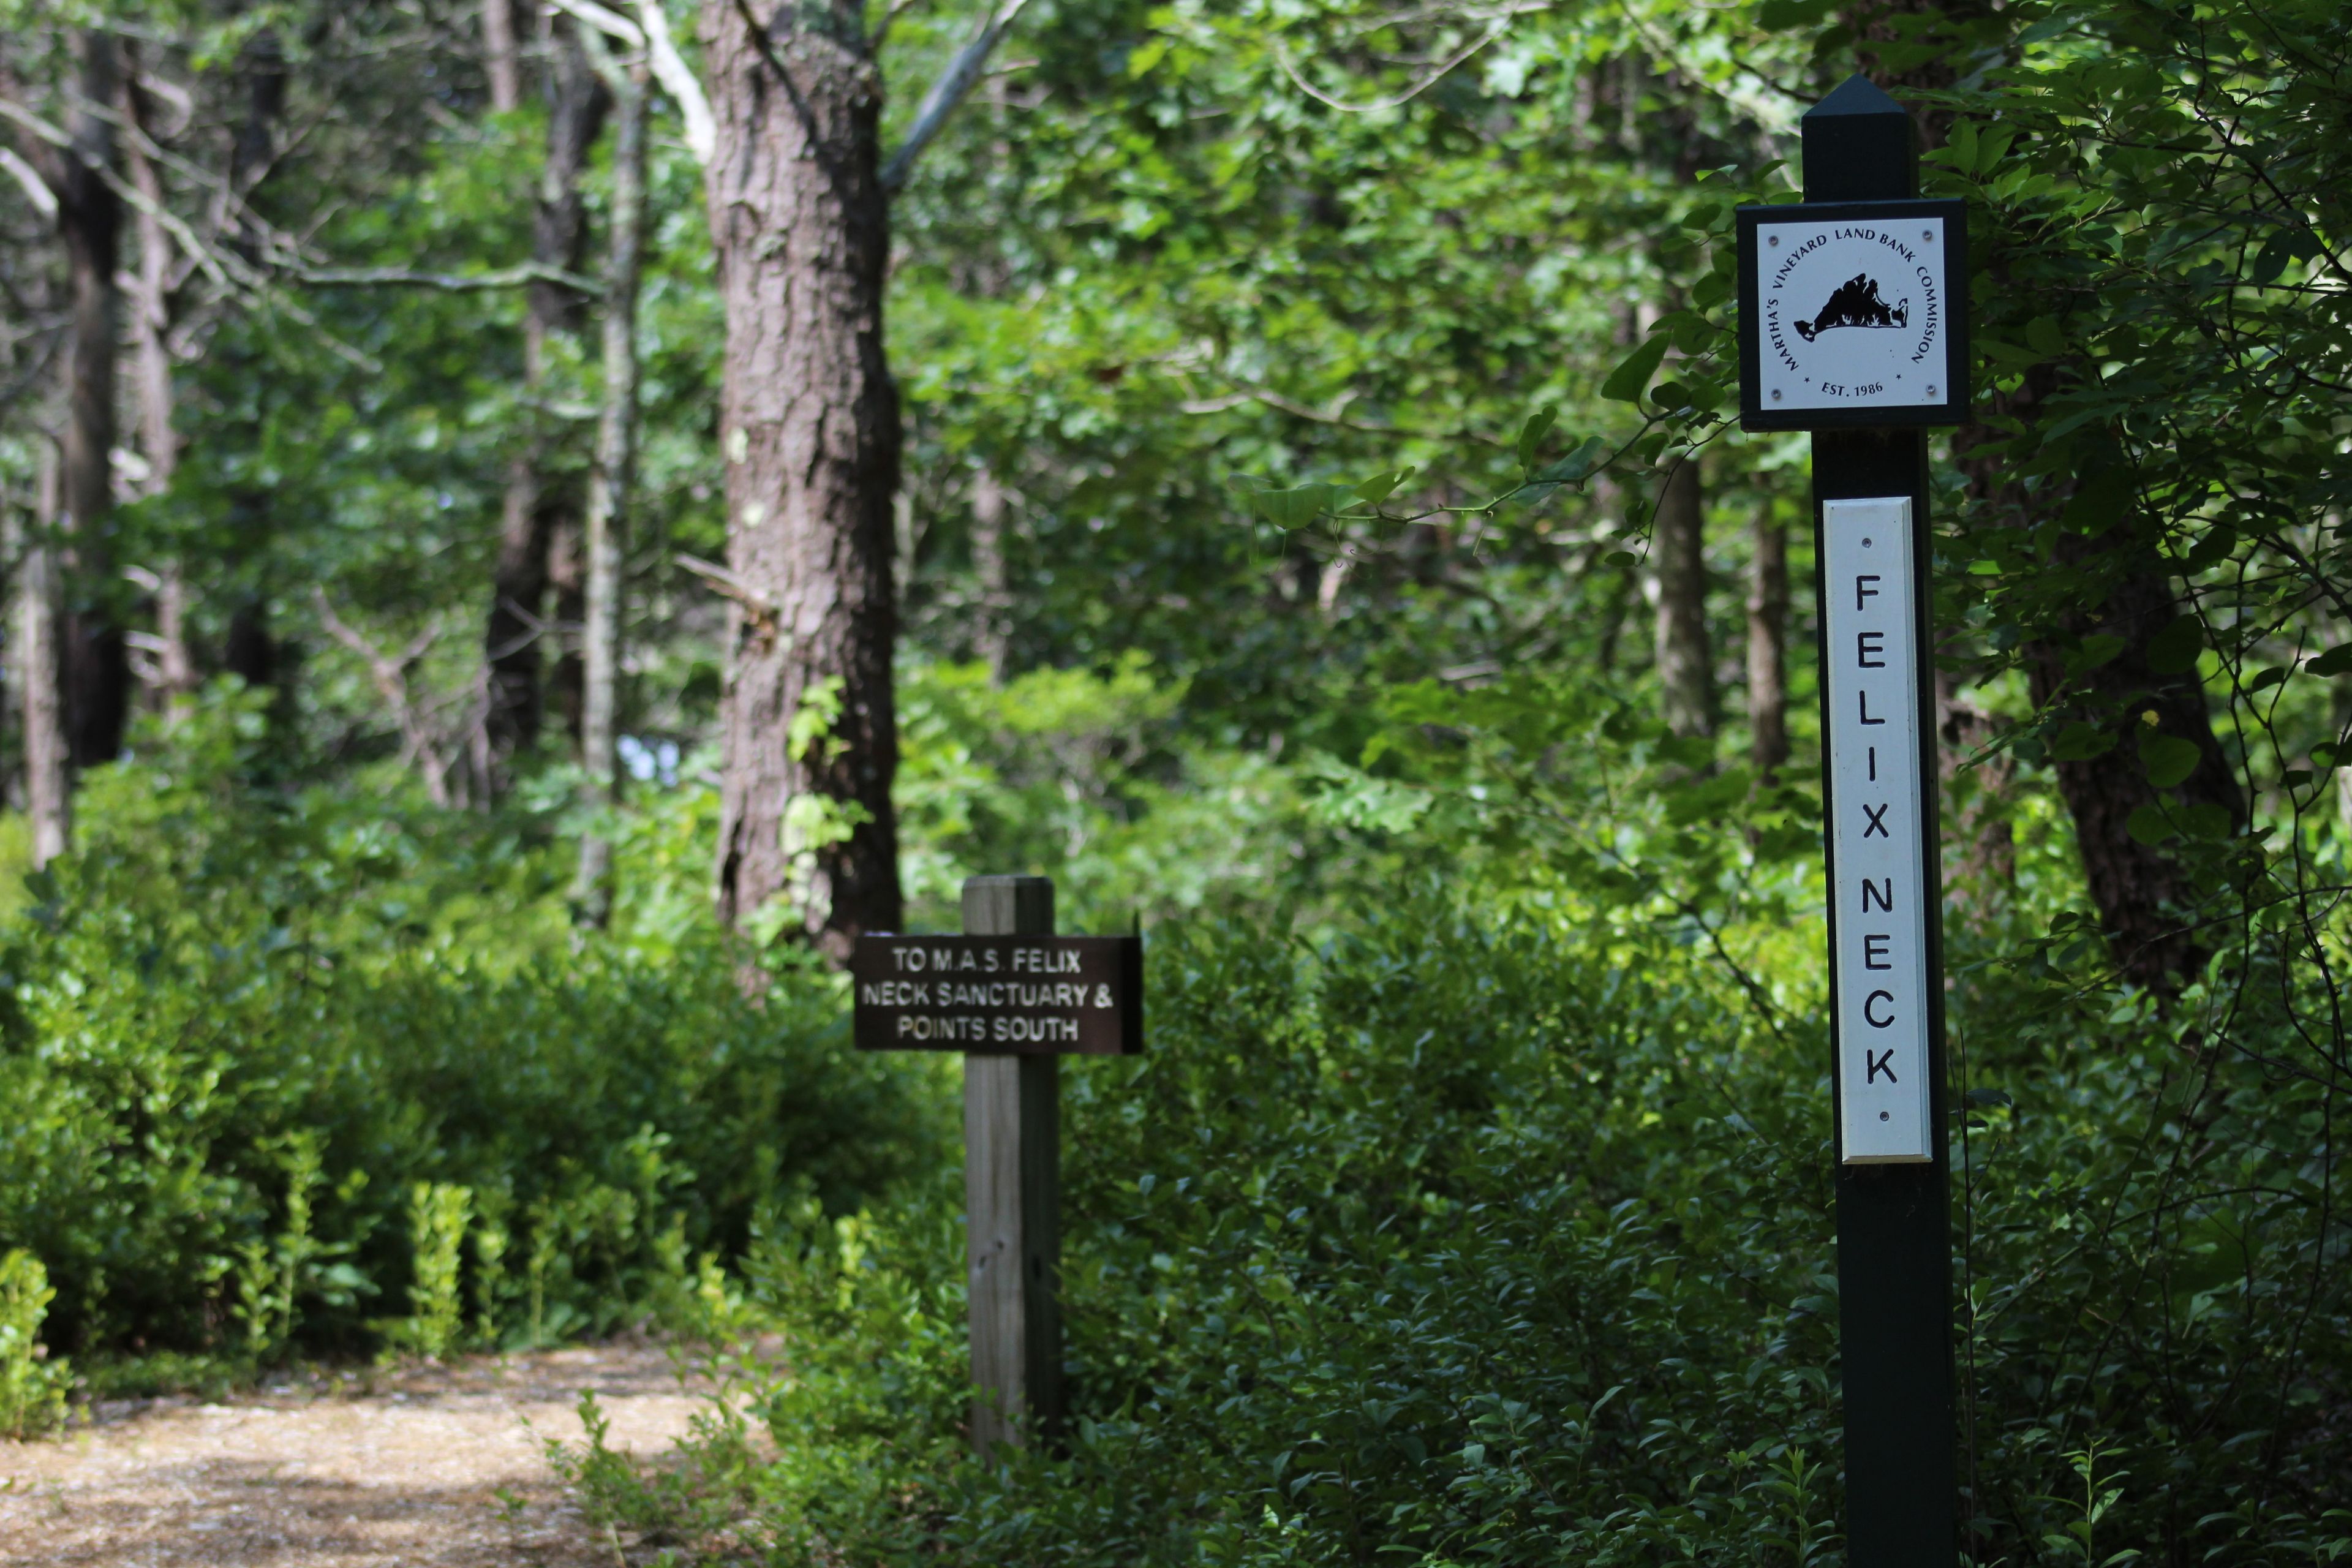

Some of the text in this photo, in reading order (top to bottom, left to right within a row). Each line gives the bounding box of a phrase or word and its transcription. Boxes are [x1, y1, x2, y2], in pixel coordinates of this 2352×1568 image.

[1766, 228, 1937, 371] MARTHA'S VINEYARD LAND BANK COMMISSION
[1822, 382, 1883, 398] EST. 1986
[1856, 575, 1898, 1084] FELIX NECK
[892, 947, 925, 972] TO
[1012, 948, 1082, 973] FELIX
[862, 982, 1114, 1008] NECK SANCTUARY &
[897, 1015, 1079, 1041] POINTS SOUTH
